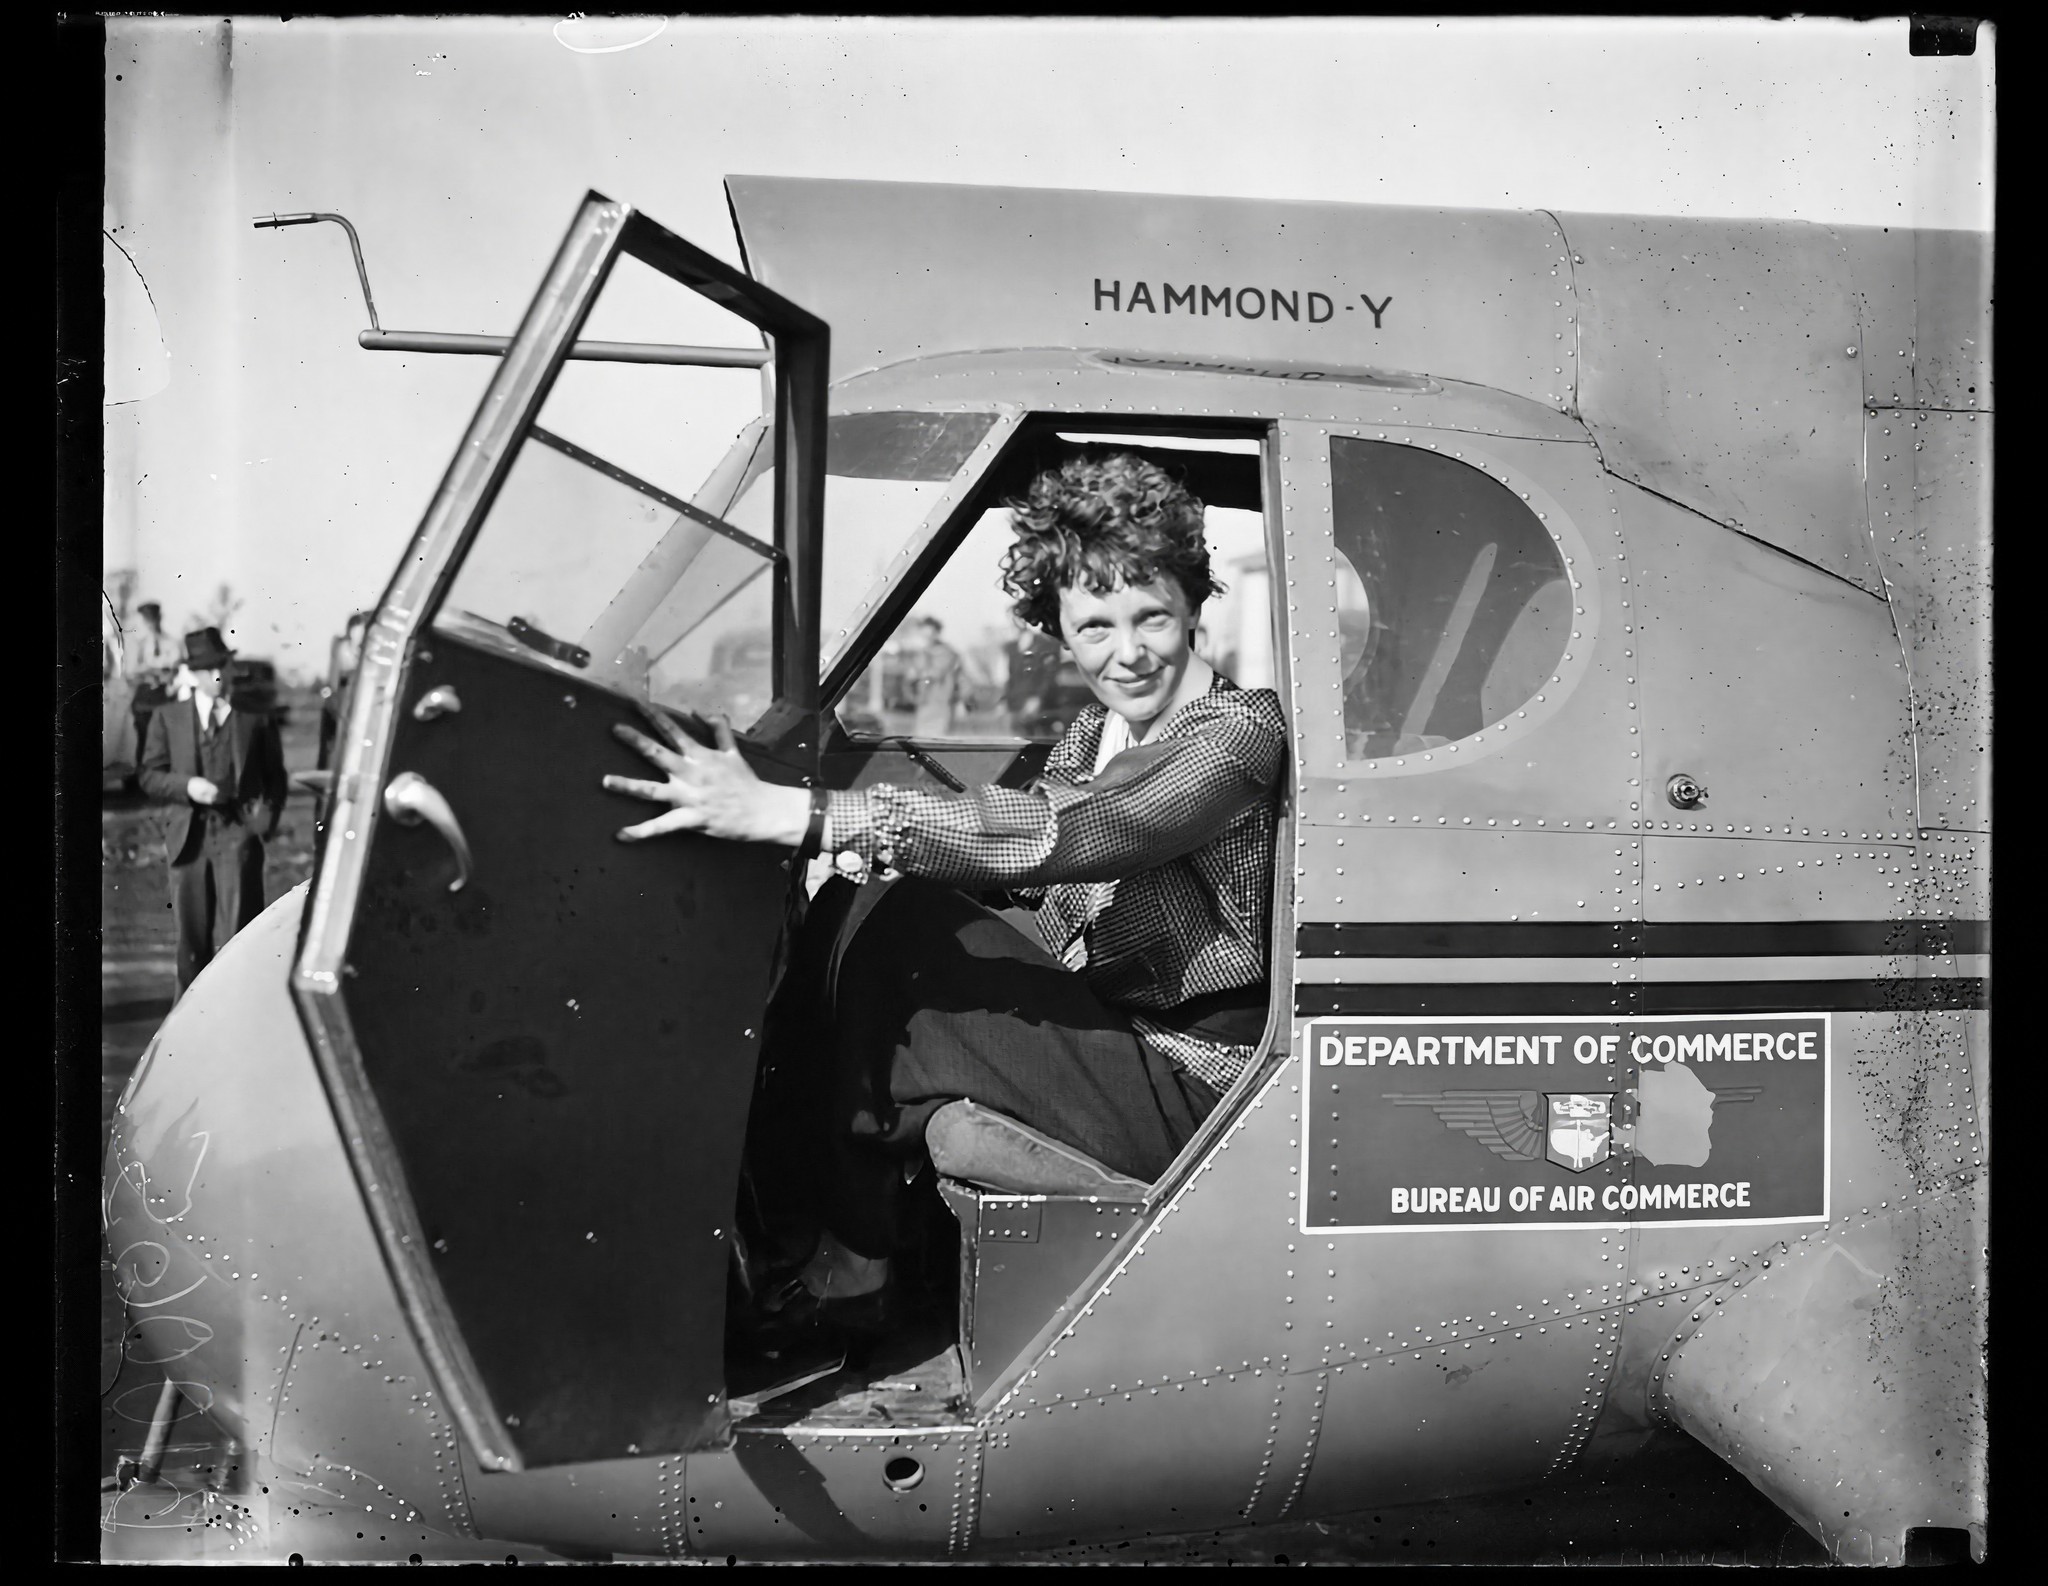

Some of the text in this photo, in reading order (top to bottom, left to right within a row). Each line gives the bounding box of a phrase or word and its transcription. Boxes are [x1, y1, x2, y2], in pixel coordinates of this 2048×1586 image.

[1319, 1031, 1818, 1066] DEPARTMENT OF COMMERCE
[1391, 1182, 1751, 1214] BUREAU OF AIR COMMERCE
